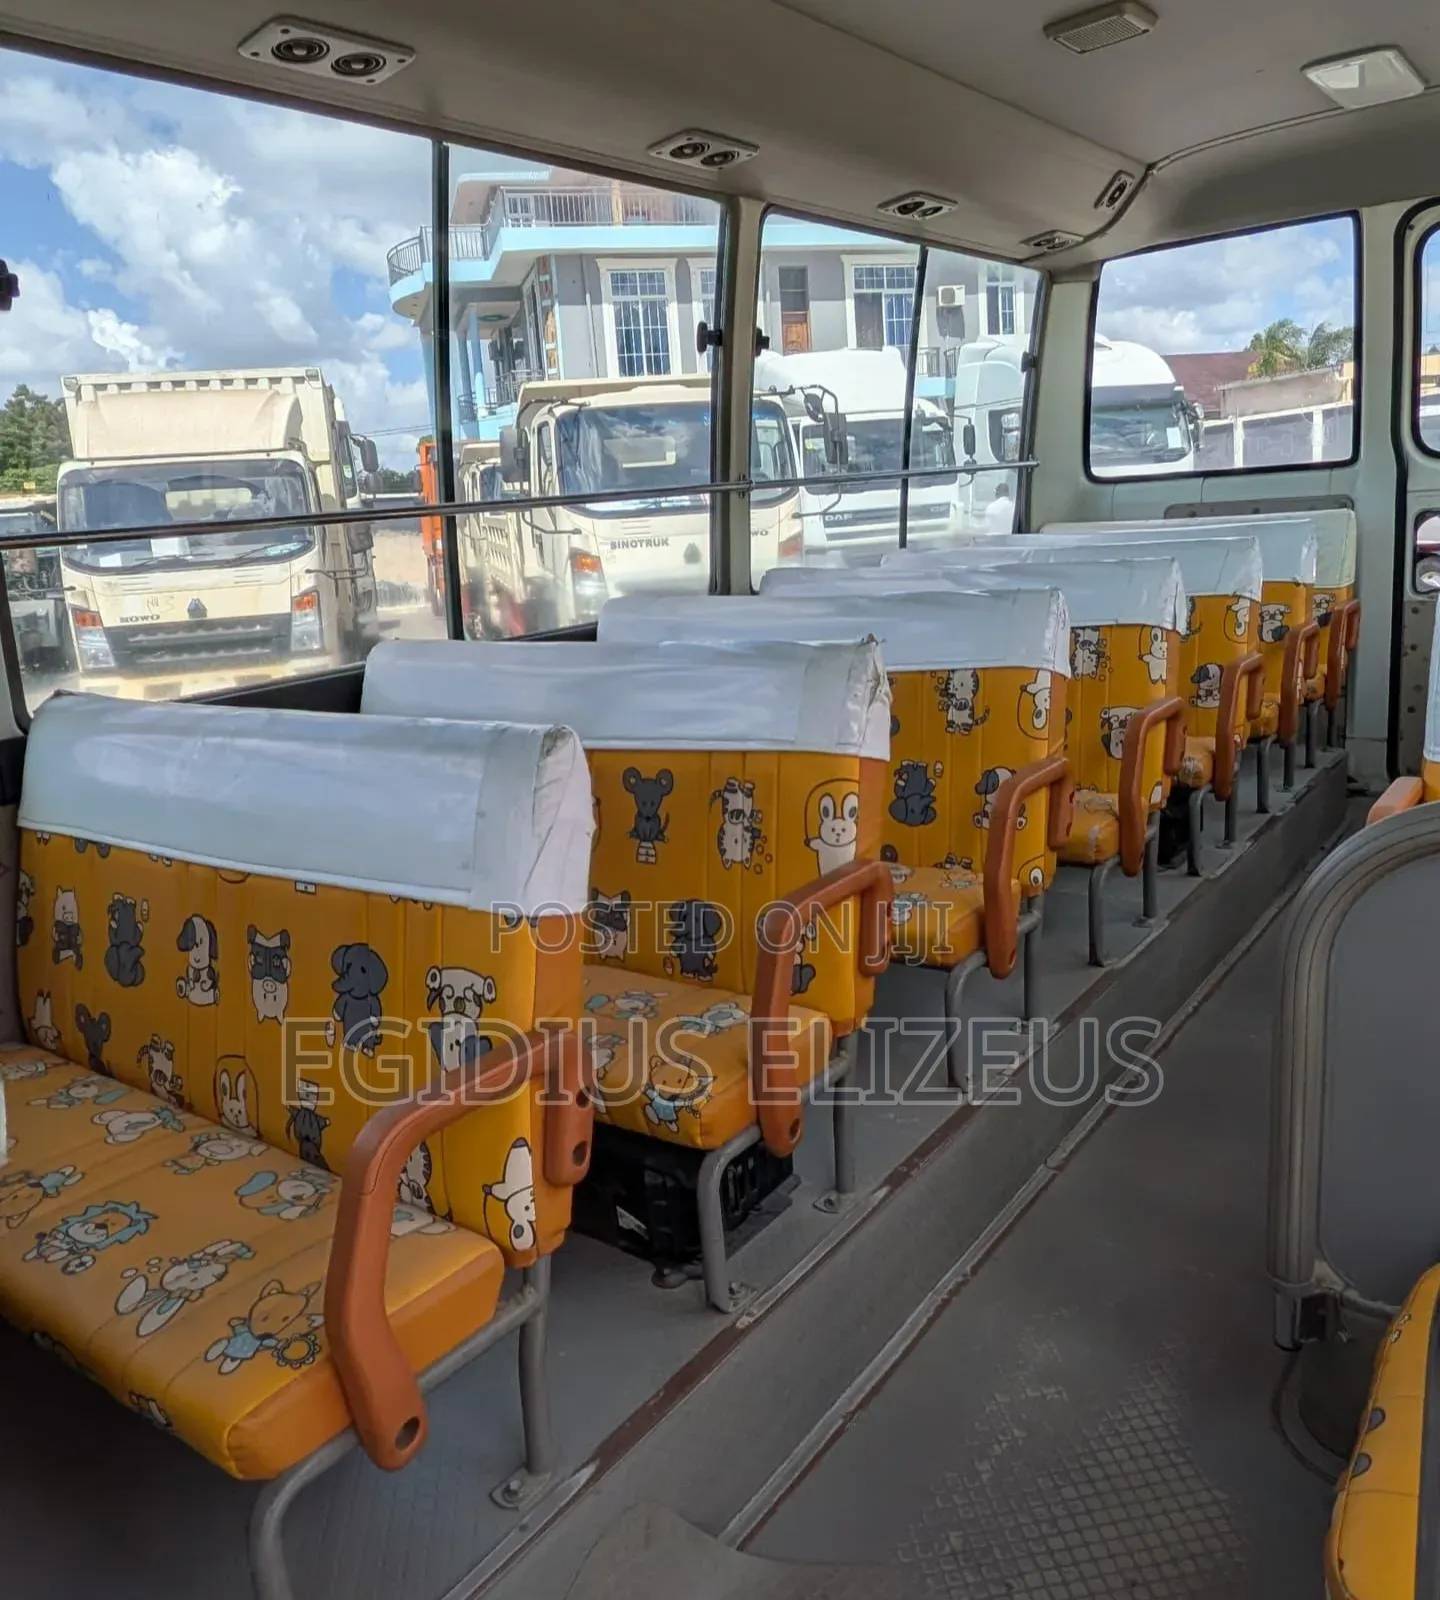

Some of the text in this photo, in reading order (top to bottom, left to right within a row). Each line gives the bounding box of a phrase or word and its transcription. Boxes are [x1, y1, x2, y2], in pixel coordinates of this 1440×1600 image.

[824, 513, 852, 521] DAF
[610, 538, 669, 550] SINOTRUK
[119, 614, 160, 623] HOWO
